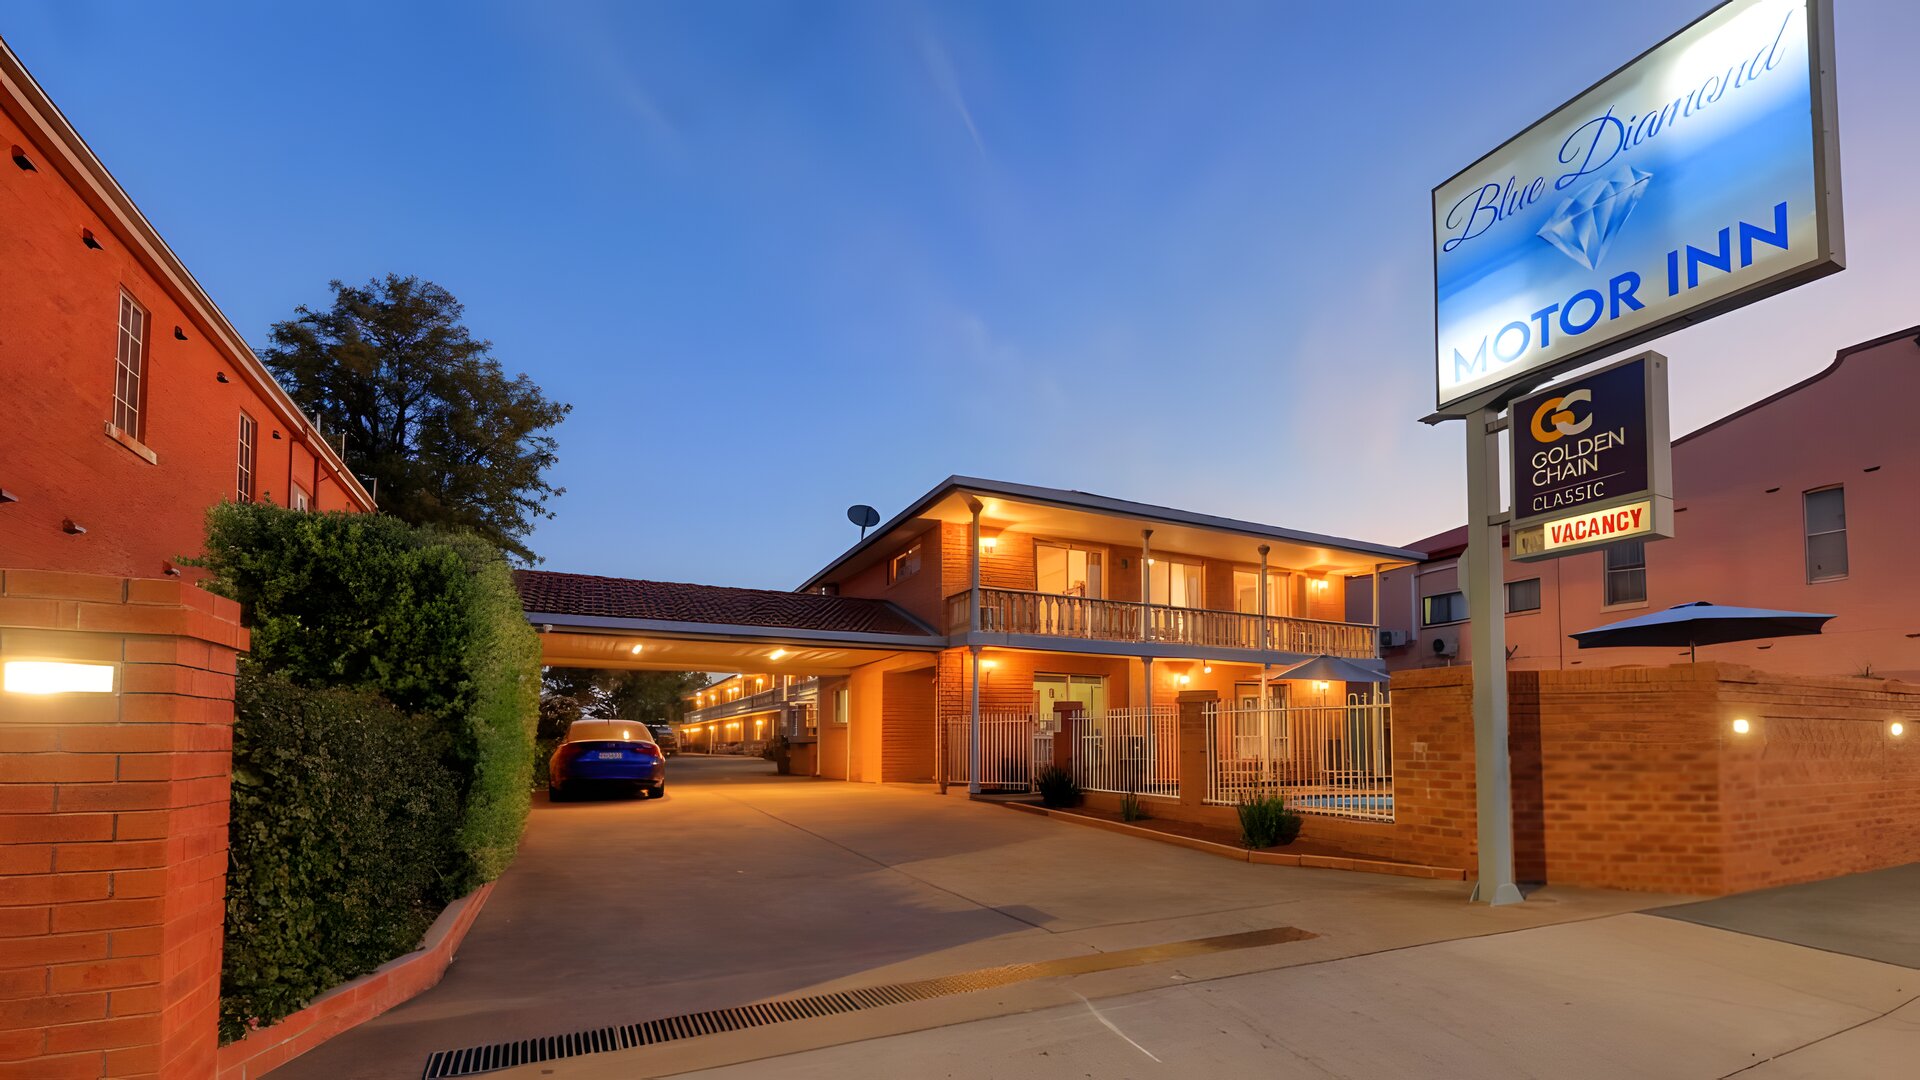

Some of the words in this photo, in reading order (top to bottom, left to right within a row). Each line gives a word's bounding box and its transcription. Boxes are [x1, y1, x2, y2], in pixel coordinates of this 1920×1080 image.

[1443, 175, 1546, 252] Blue
[1555, 10, 1794, 189] Diamond
[1453, 271, 1645, 382] MOTOR
[1667, 201, 1788, 297] INN
[1532, 427, 1624, 469] GOLDEN
[1532, 454, 1598, 487] CHAIN
[1533, 482, 1604, 511] CLASSIC
[1551, 508, 1642, 544] VACANCY
